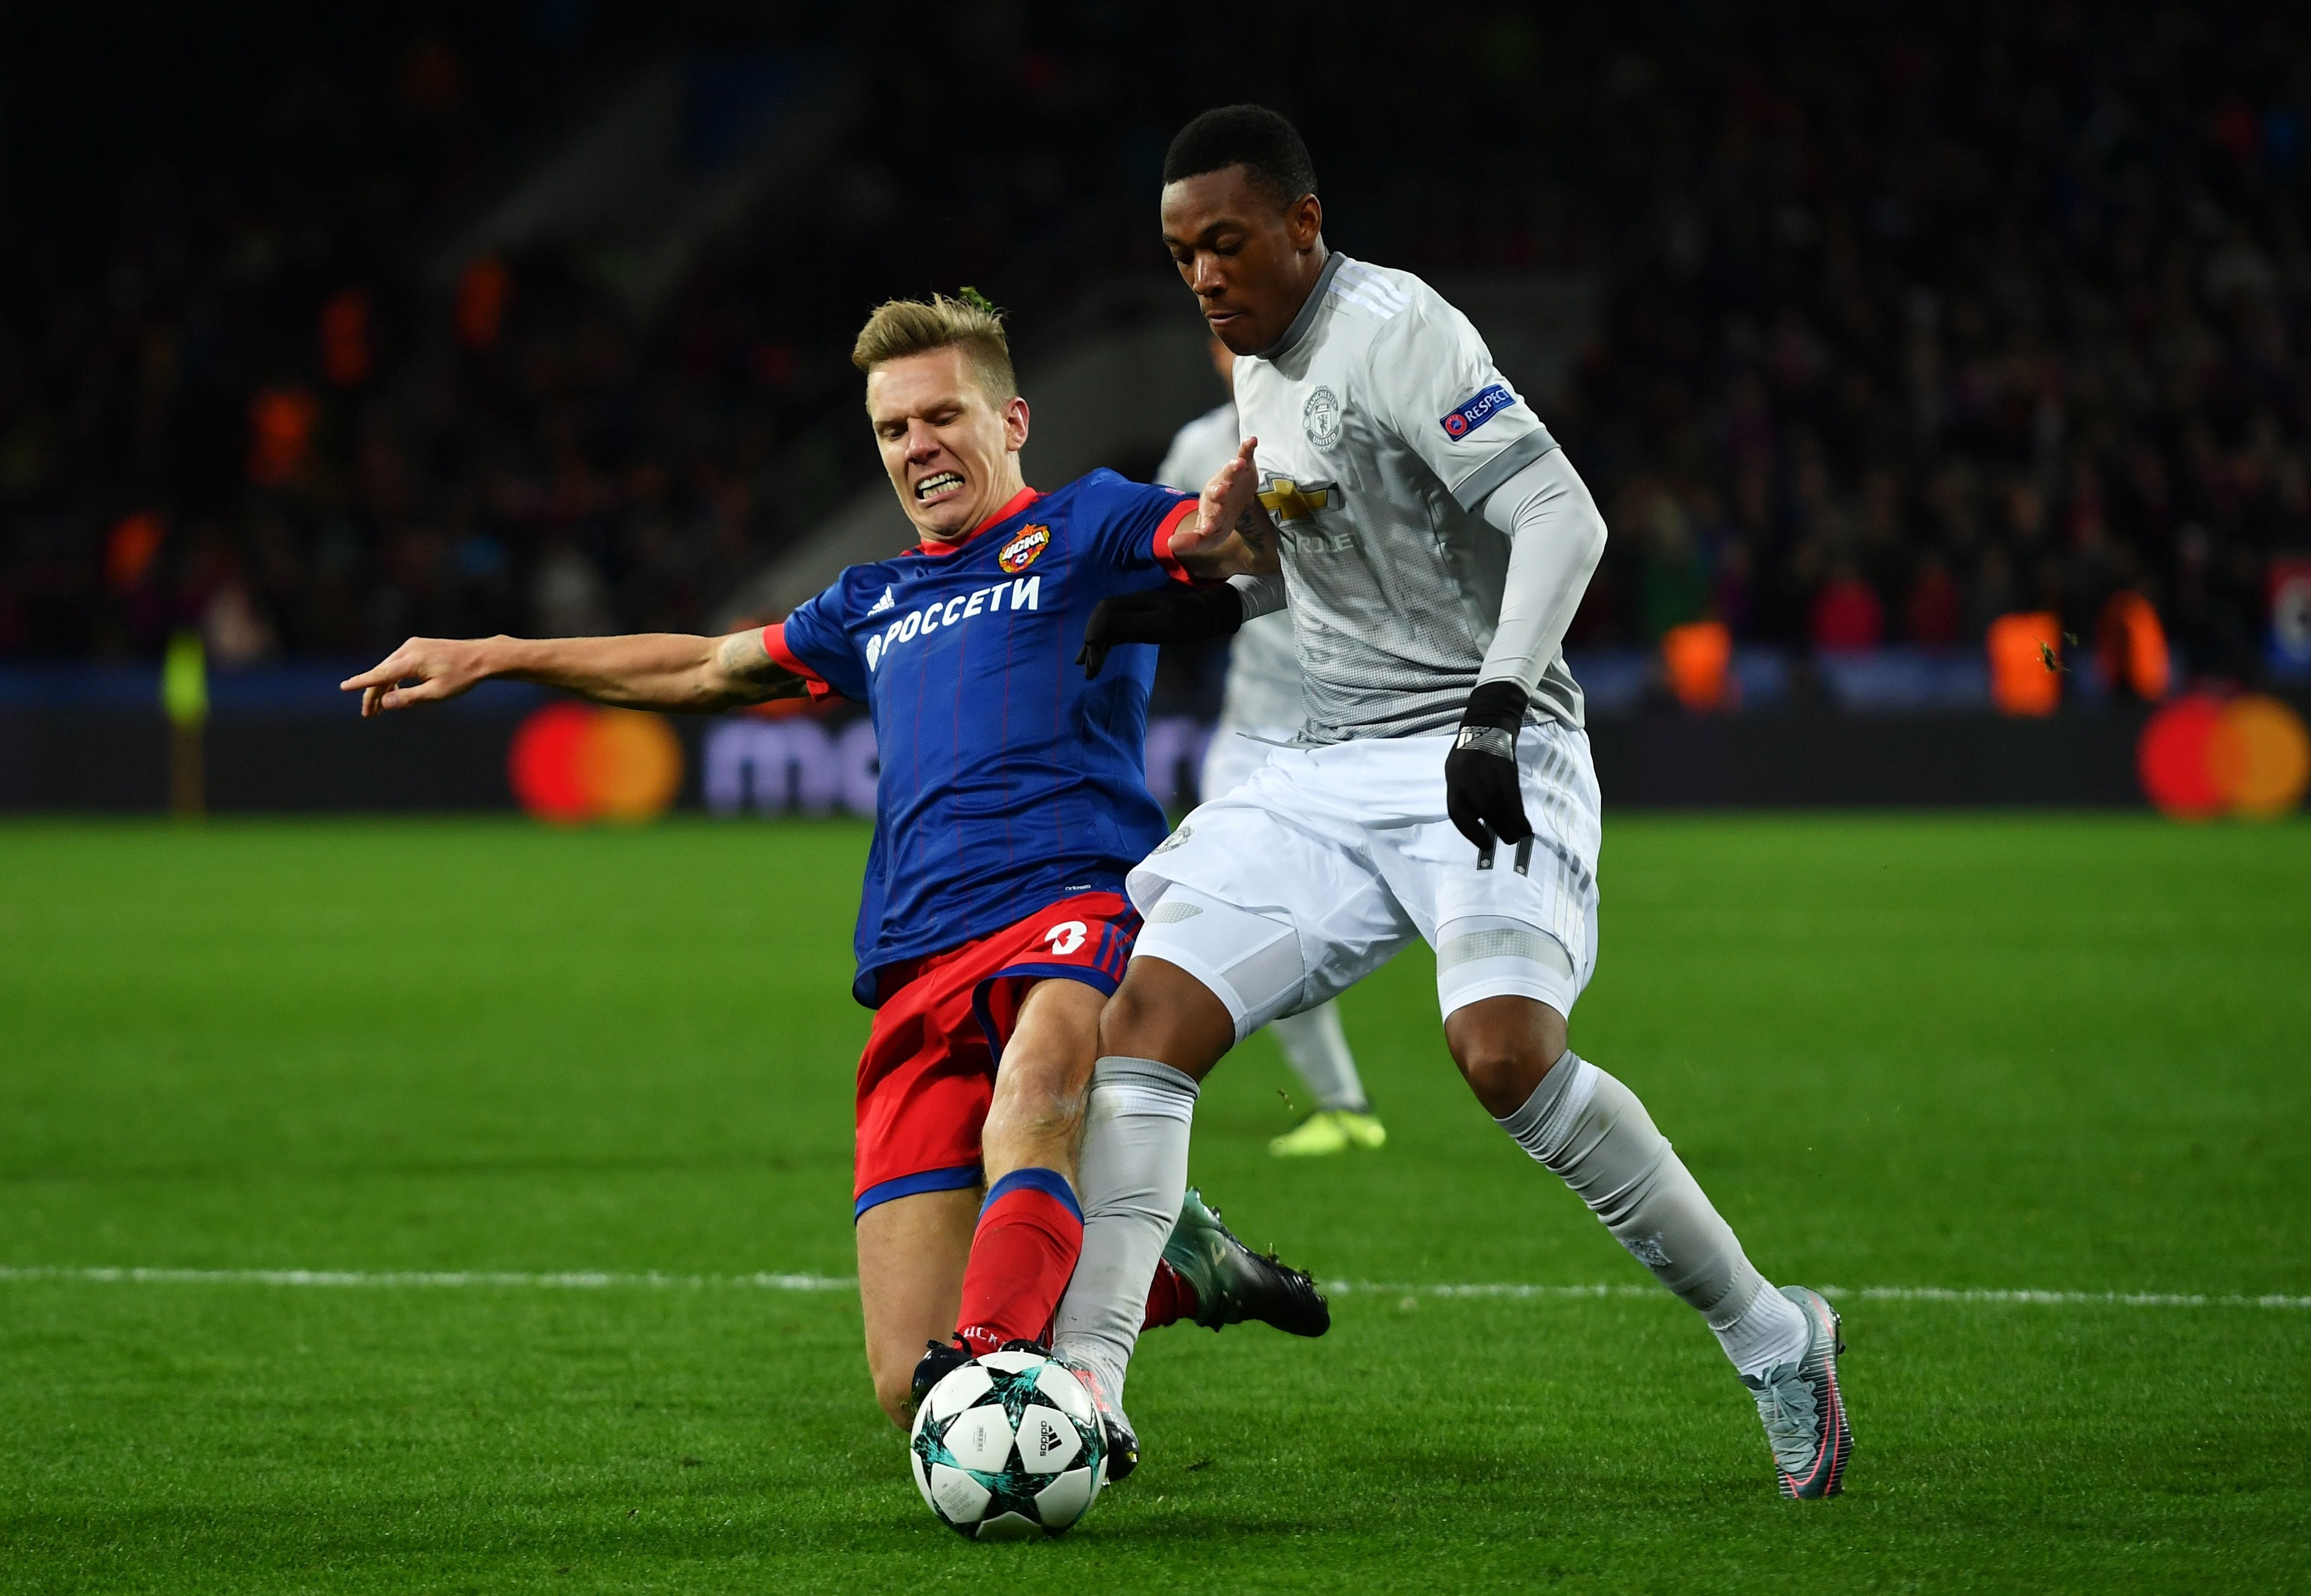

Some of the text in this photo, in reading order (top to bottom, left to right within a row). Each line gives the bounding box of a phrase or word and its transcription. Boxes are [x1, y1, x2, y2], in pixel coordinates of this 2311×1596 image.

[1464, 388, 1509, 422] RESPECT
[1312, 433, 1336, 446] UNITED
[1002, 531, 1045, 560] ЦСКА
[881, 576, 1041, 655] РОССЕТИ
[1476, 833, 1535, 878] 11
[1044, 921, 1087, 955] 3
[1040, 1420, 1049, 1457] adidas
